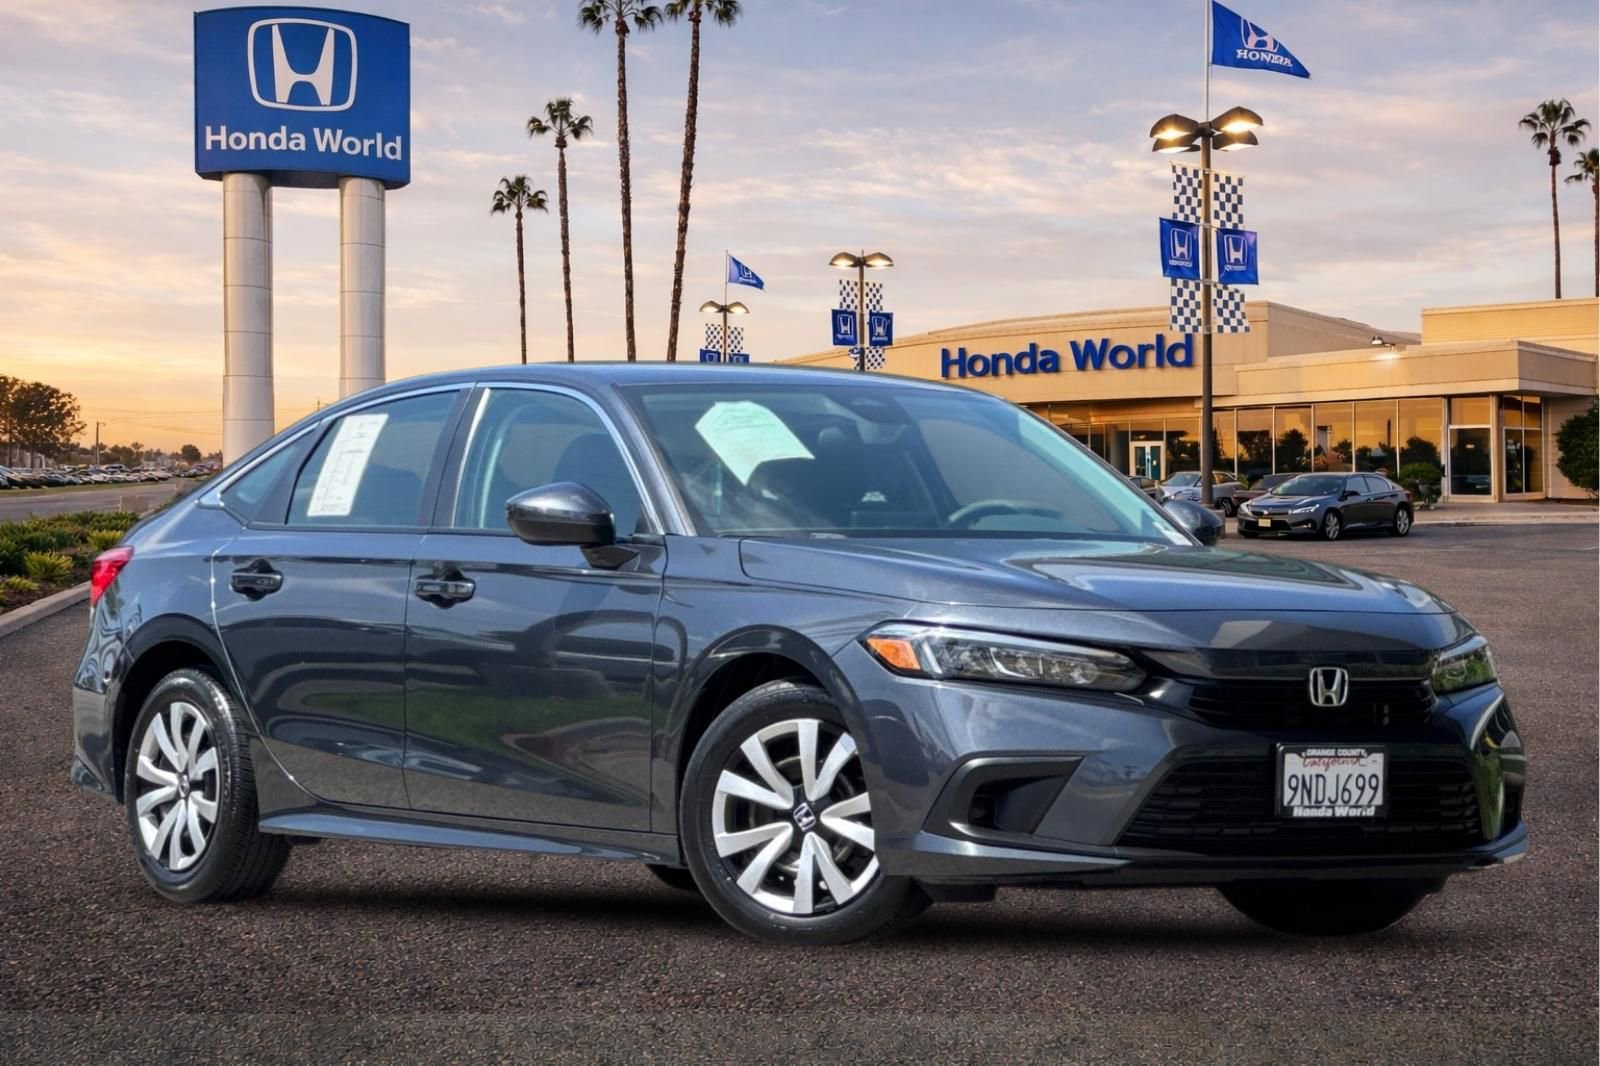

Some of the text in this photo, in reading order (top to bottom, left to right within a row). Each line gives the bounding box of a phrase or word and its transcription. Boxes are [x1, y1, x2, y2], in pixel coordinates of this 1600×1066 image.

[205, 125, 402, 160] Honda World
[941, 333, 1194, 379] Honda World
[1287, 773, 1380, 806] 9NDJ699
[1293, 806, 1376, 817] Honda World
